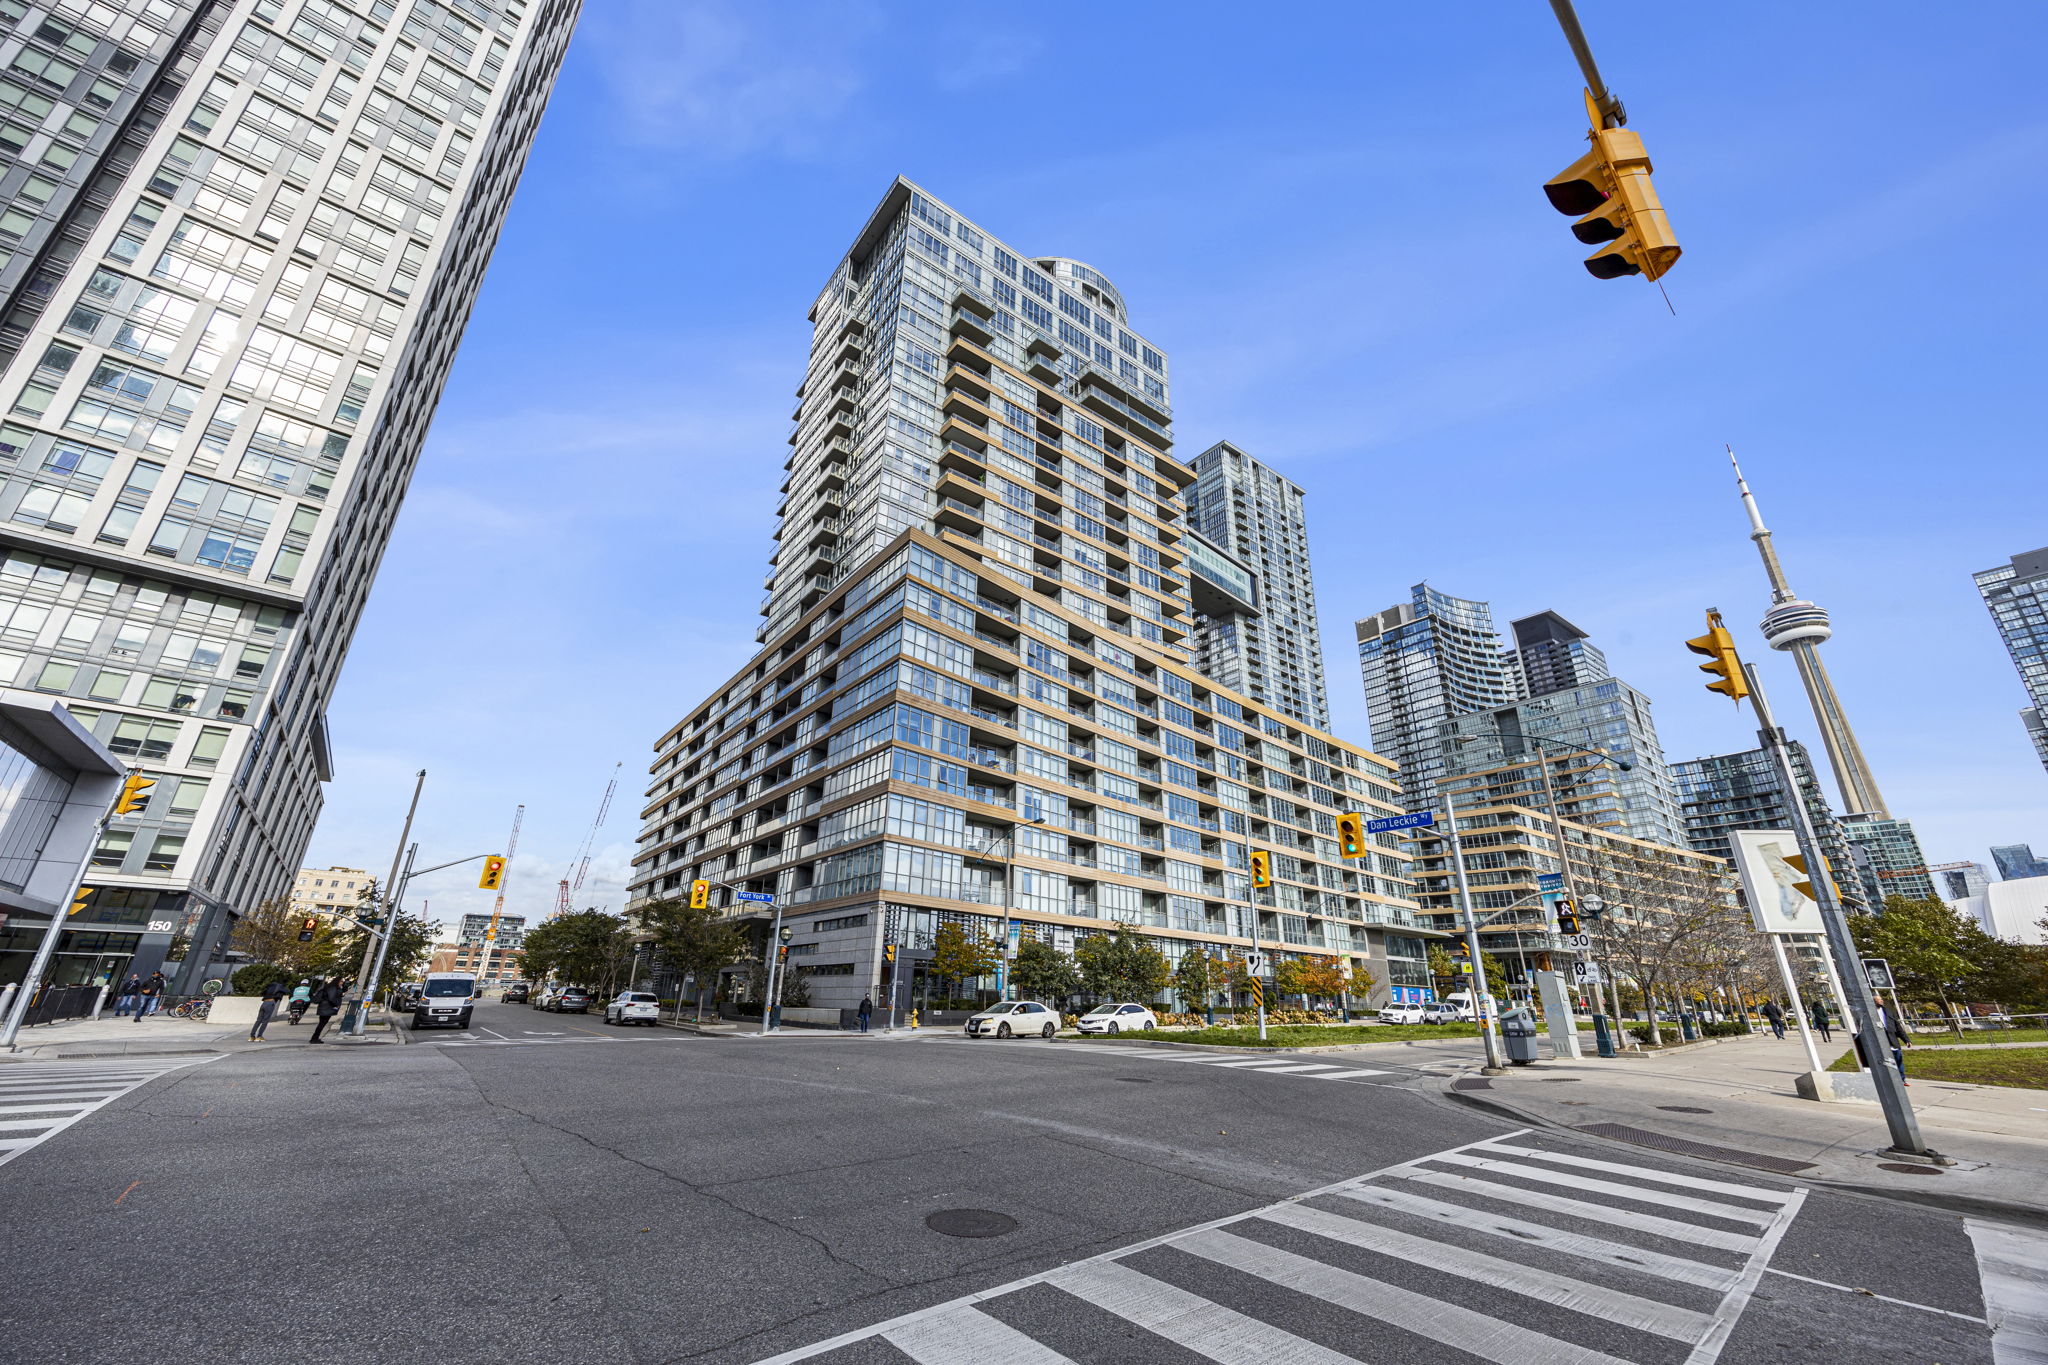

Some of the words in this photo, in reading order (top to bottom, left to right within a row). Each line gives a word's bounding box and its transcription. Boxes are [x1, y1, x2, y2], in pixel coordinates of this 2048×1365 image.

[1370, 821, 1387, 830] Dan
[1389, 816, 1418, 828] Leckie
[148, 921, 171, 931] 150
[1570, 935, 1588, 946] 30
